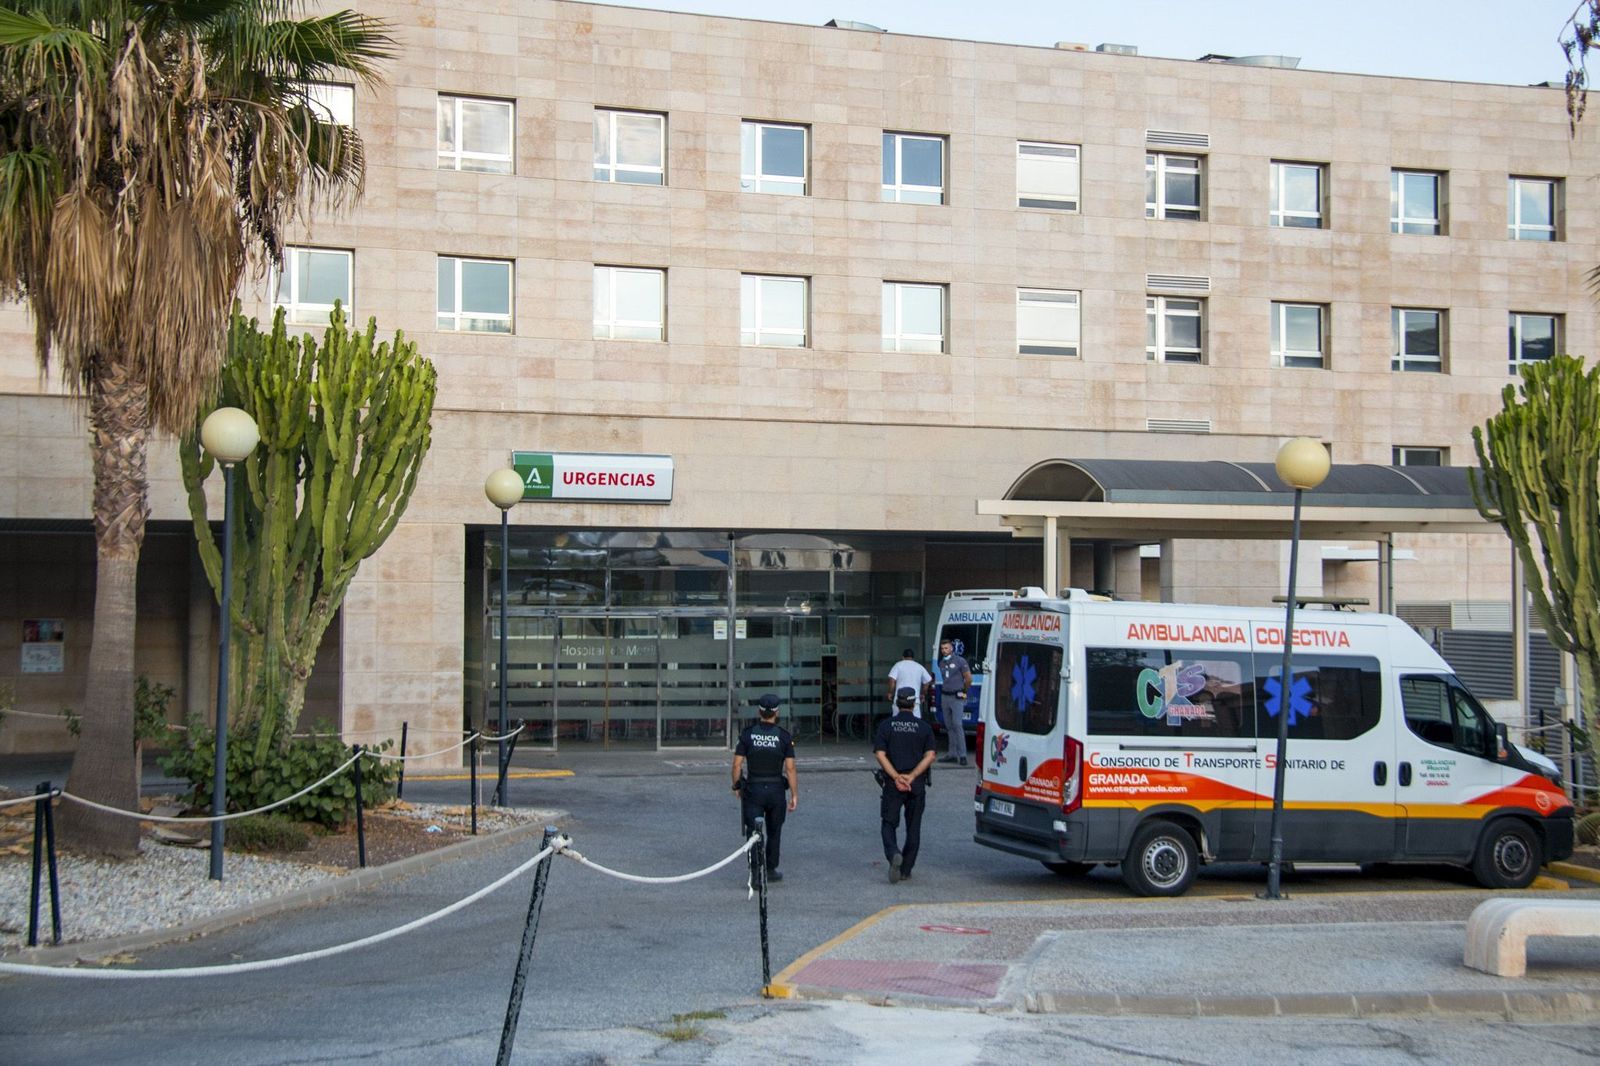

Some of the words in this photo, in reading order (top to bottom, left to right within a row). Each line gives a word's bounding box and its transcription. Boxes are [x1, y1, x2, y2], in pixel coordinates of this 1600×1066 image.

[562, 471, 656, 487] URGENCIAS
[947, 612, 994, 622] AMBULAN
[1001, 612, 1061, 632] AMBULANCIA
[1127, 623, 1246, 644] AMBULANCIA
[1256, 626, 1350, 647] COLECTIVA
[561, 644, 605, 657] Hospital
[1136, 660, 1207, 719] CTS
[750, 733, 779, 742] POLICIA
[753, 740, 777, 748] LOCAL
[1265, 754, 1327, 769] SNITARIO
[1088, 773, 1150, 785] GRANADA
